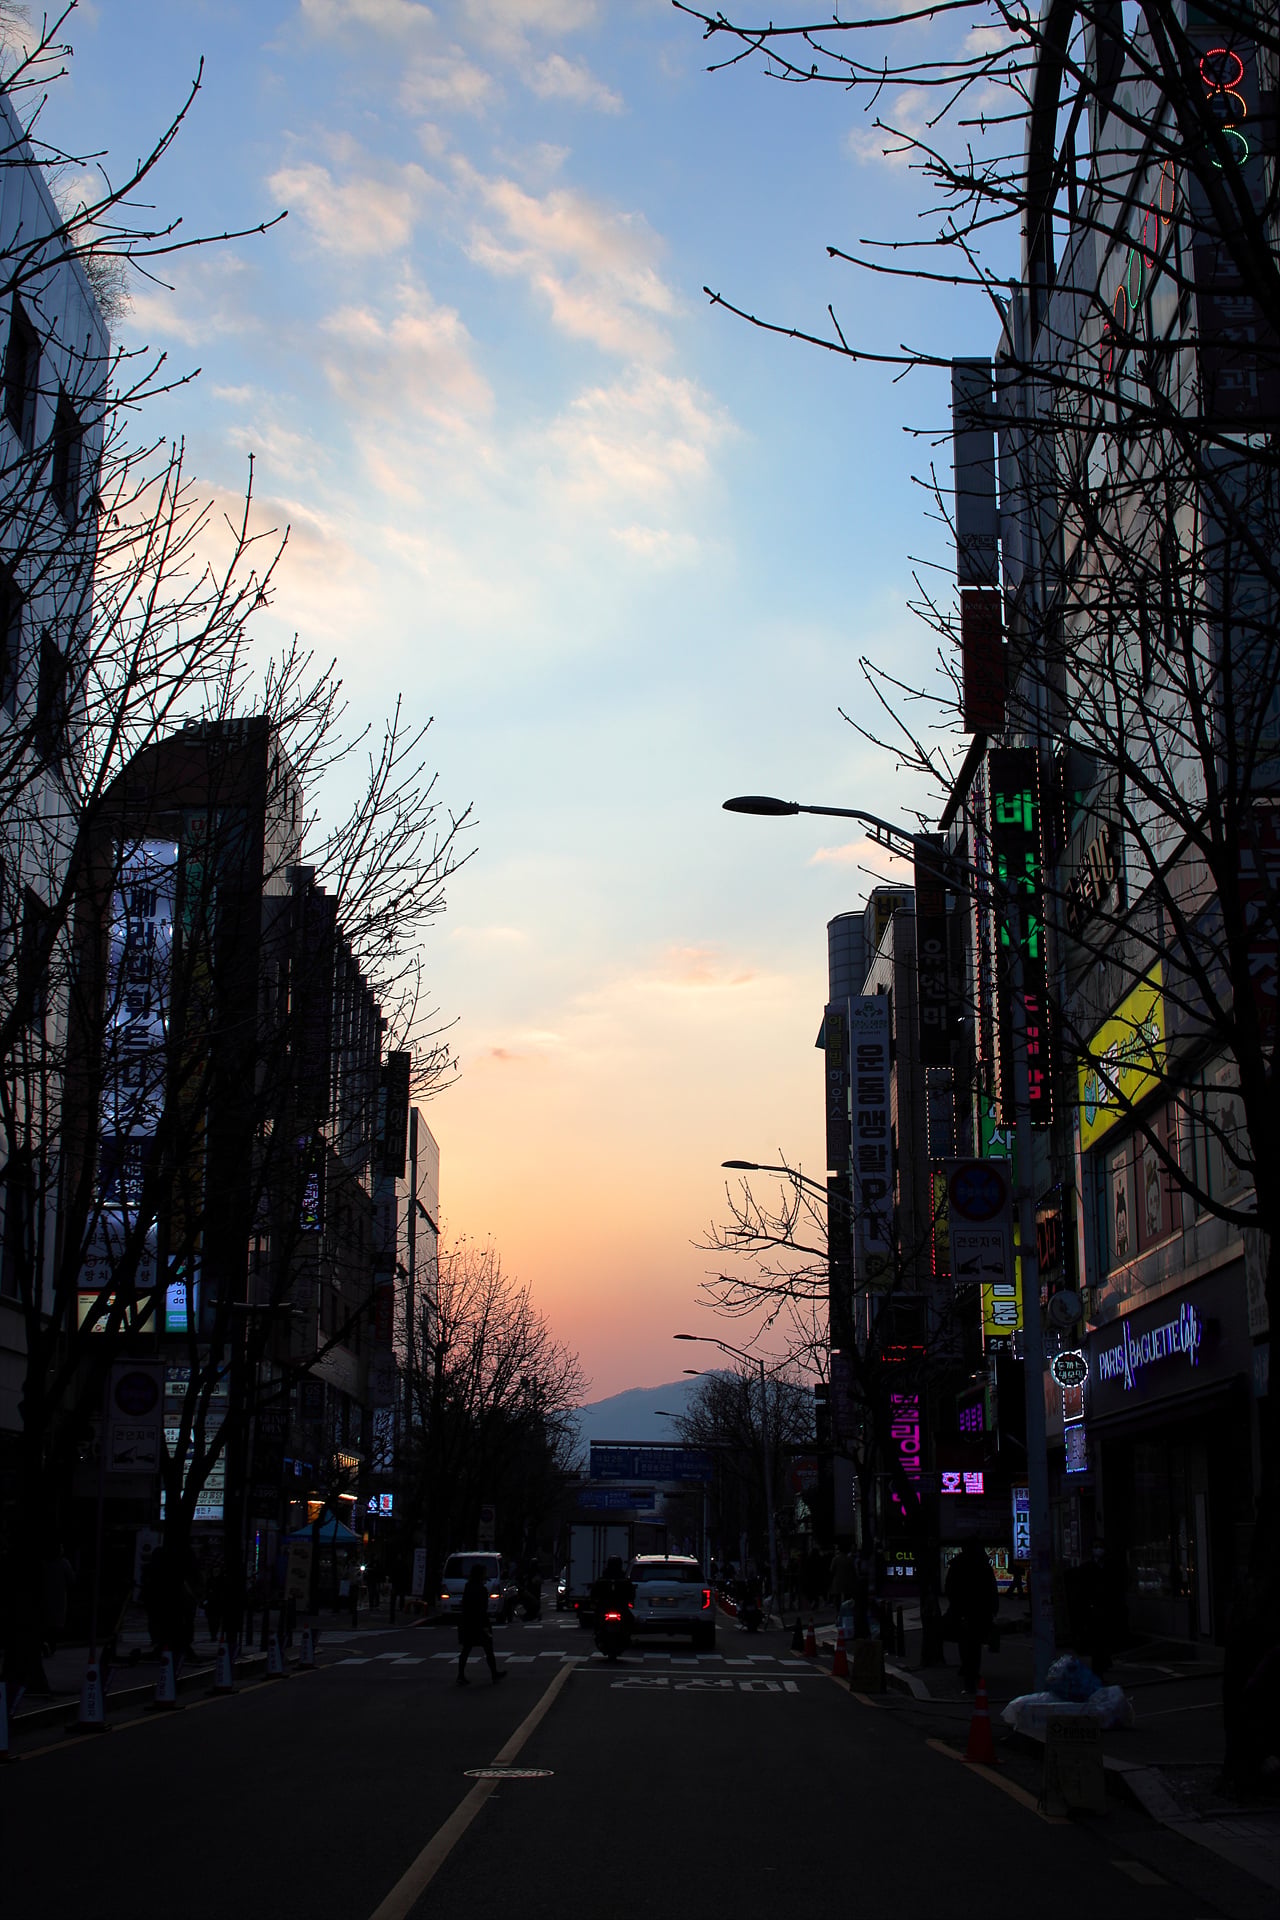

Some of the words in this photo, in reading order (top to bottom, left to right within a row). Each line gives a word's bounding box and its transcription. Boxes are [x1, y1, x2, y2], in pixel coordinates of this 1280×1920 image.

[956, 1236, 1001, 1248] 견인지역
[1098, 1344, 1124, 1382] PARIS
[1129, 1319, 1180, 1369] BAGUETTE
[940, 1471, 984, 1495] 호텔
